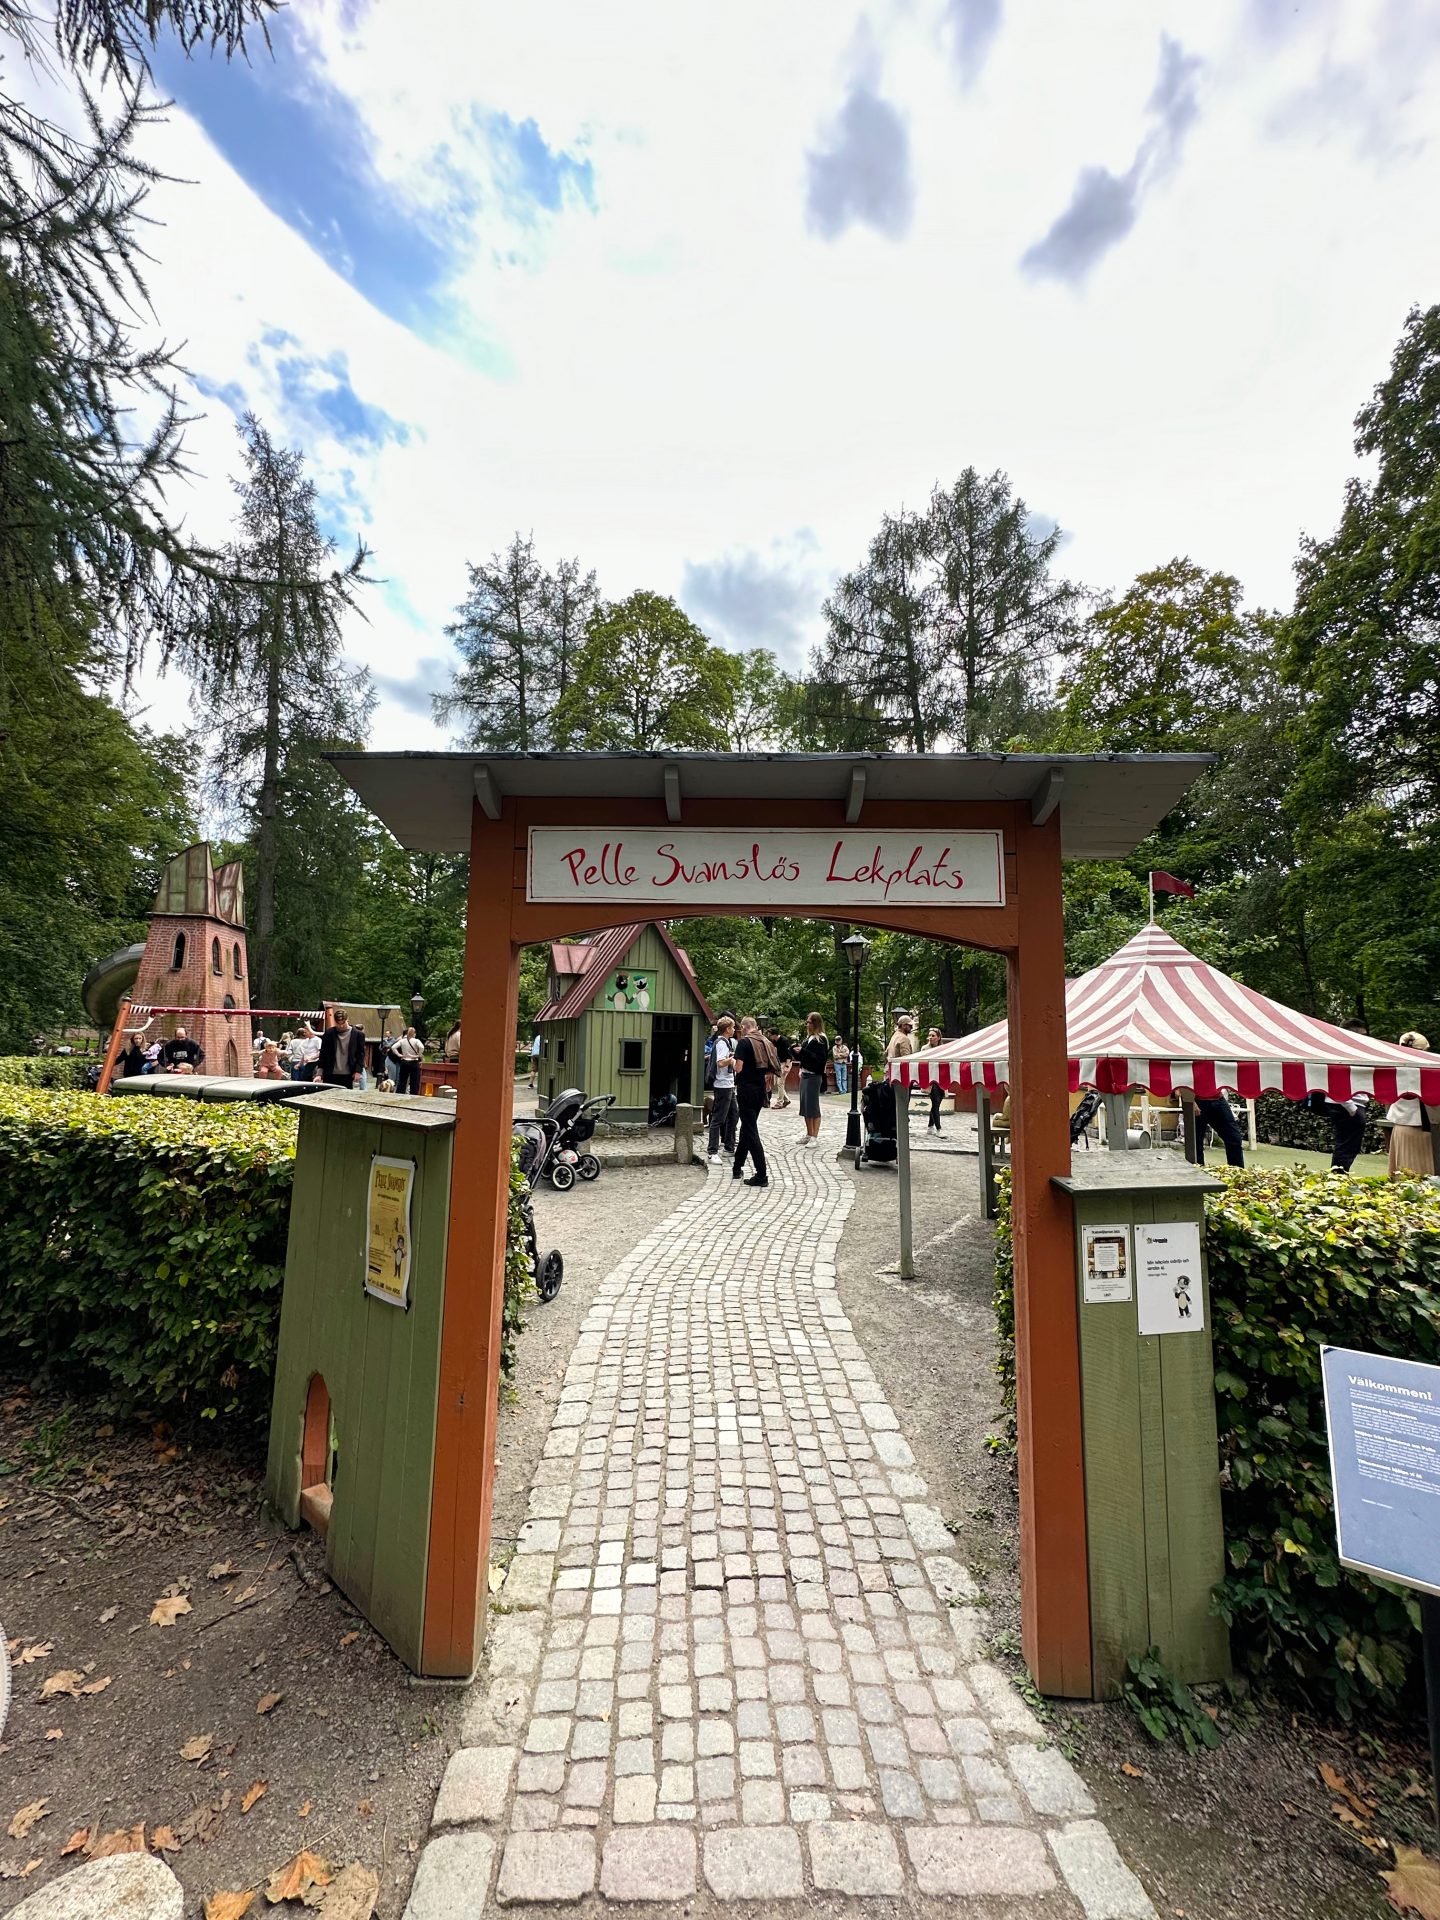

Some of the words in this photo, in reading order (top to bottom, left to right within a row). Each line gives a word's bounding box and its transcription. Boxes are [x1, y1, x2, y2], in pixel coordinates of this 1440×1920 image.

[560, 842, 640, 886] Pelle
[652, 843, 801, 887] Svanslös
[826, 840, 965, 901] Lekplats
[1347, 1374, 1433, 1401] Välkommen!
